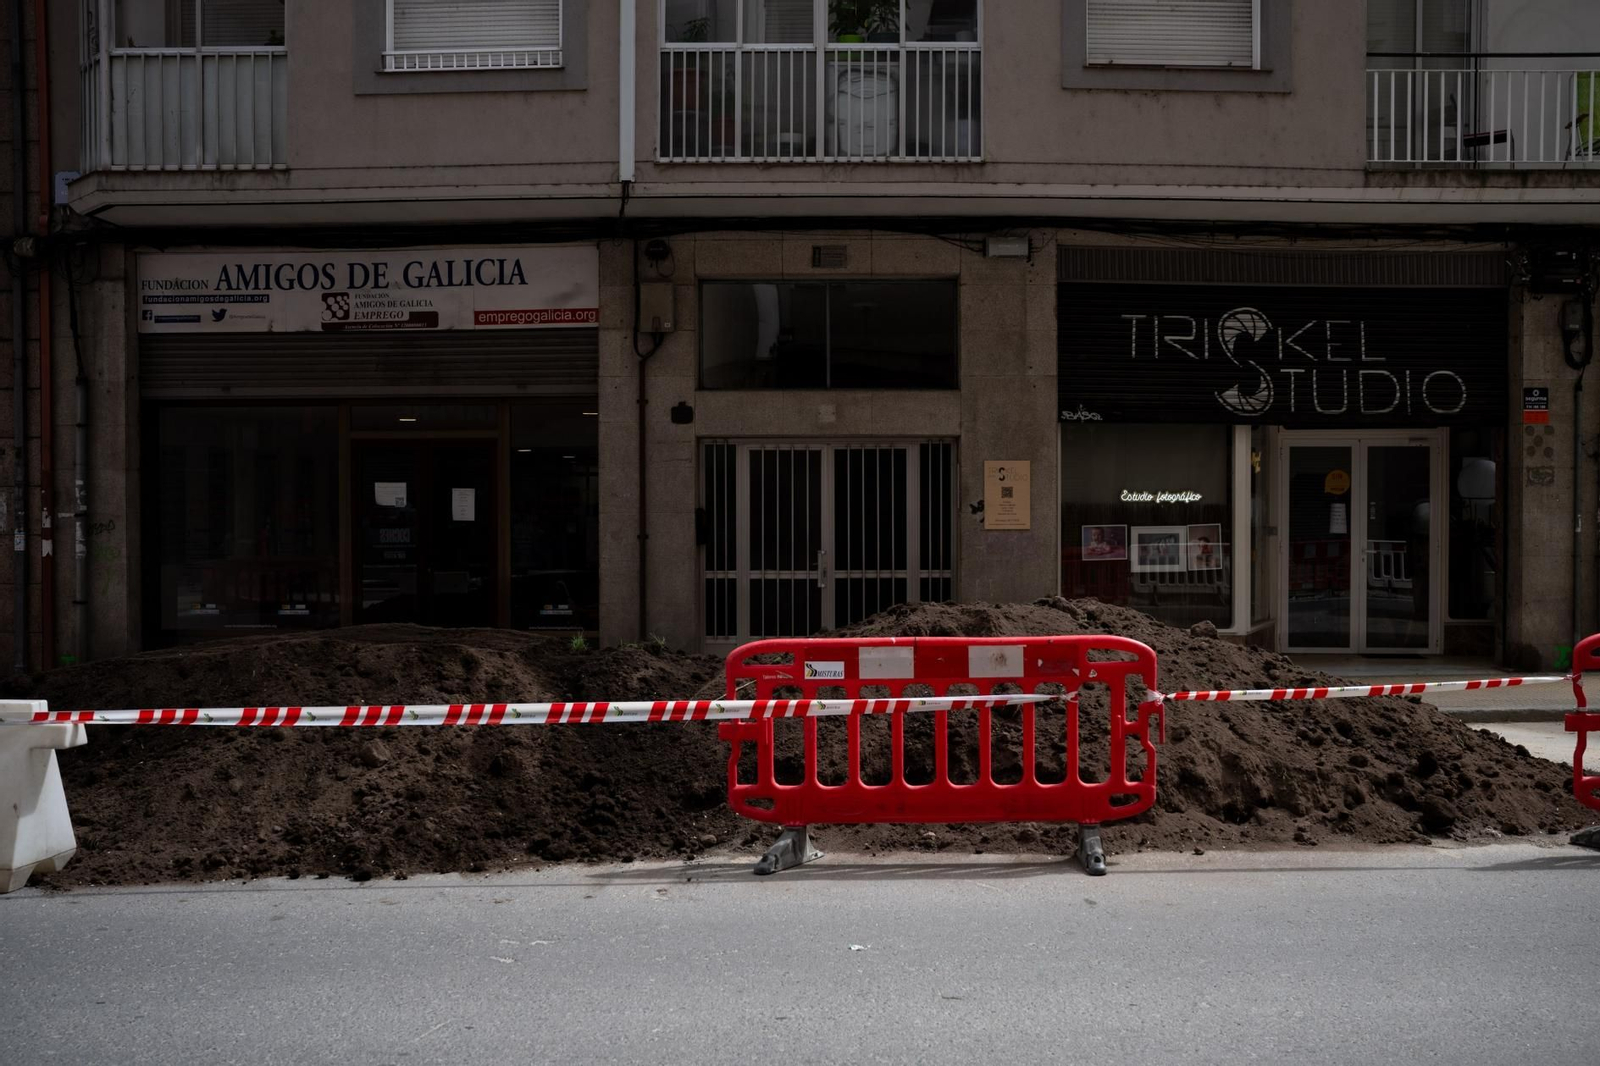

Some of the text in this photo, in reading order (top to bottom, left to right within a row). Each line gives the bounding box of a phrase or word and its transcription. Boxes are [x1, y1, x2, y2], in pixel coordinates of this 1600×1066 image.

[214, 263, 335, 291] AMIGOS
[347, 262, 389, 290] DE
[403, 258, 528, 288] GALICIA
[353, 299, 433, 309] AMIGOS DE GALICIA
[354, 310, 404, 320] EMPREGO
[478, 308, 596, 324] empregogalicia.org
[1121, 489, 1202, 504] Estudio fotográfico
